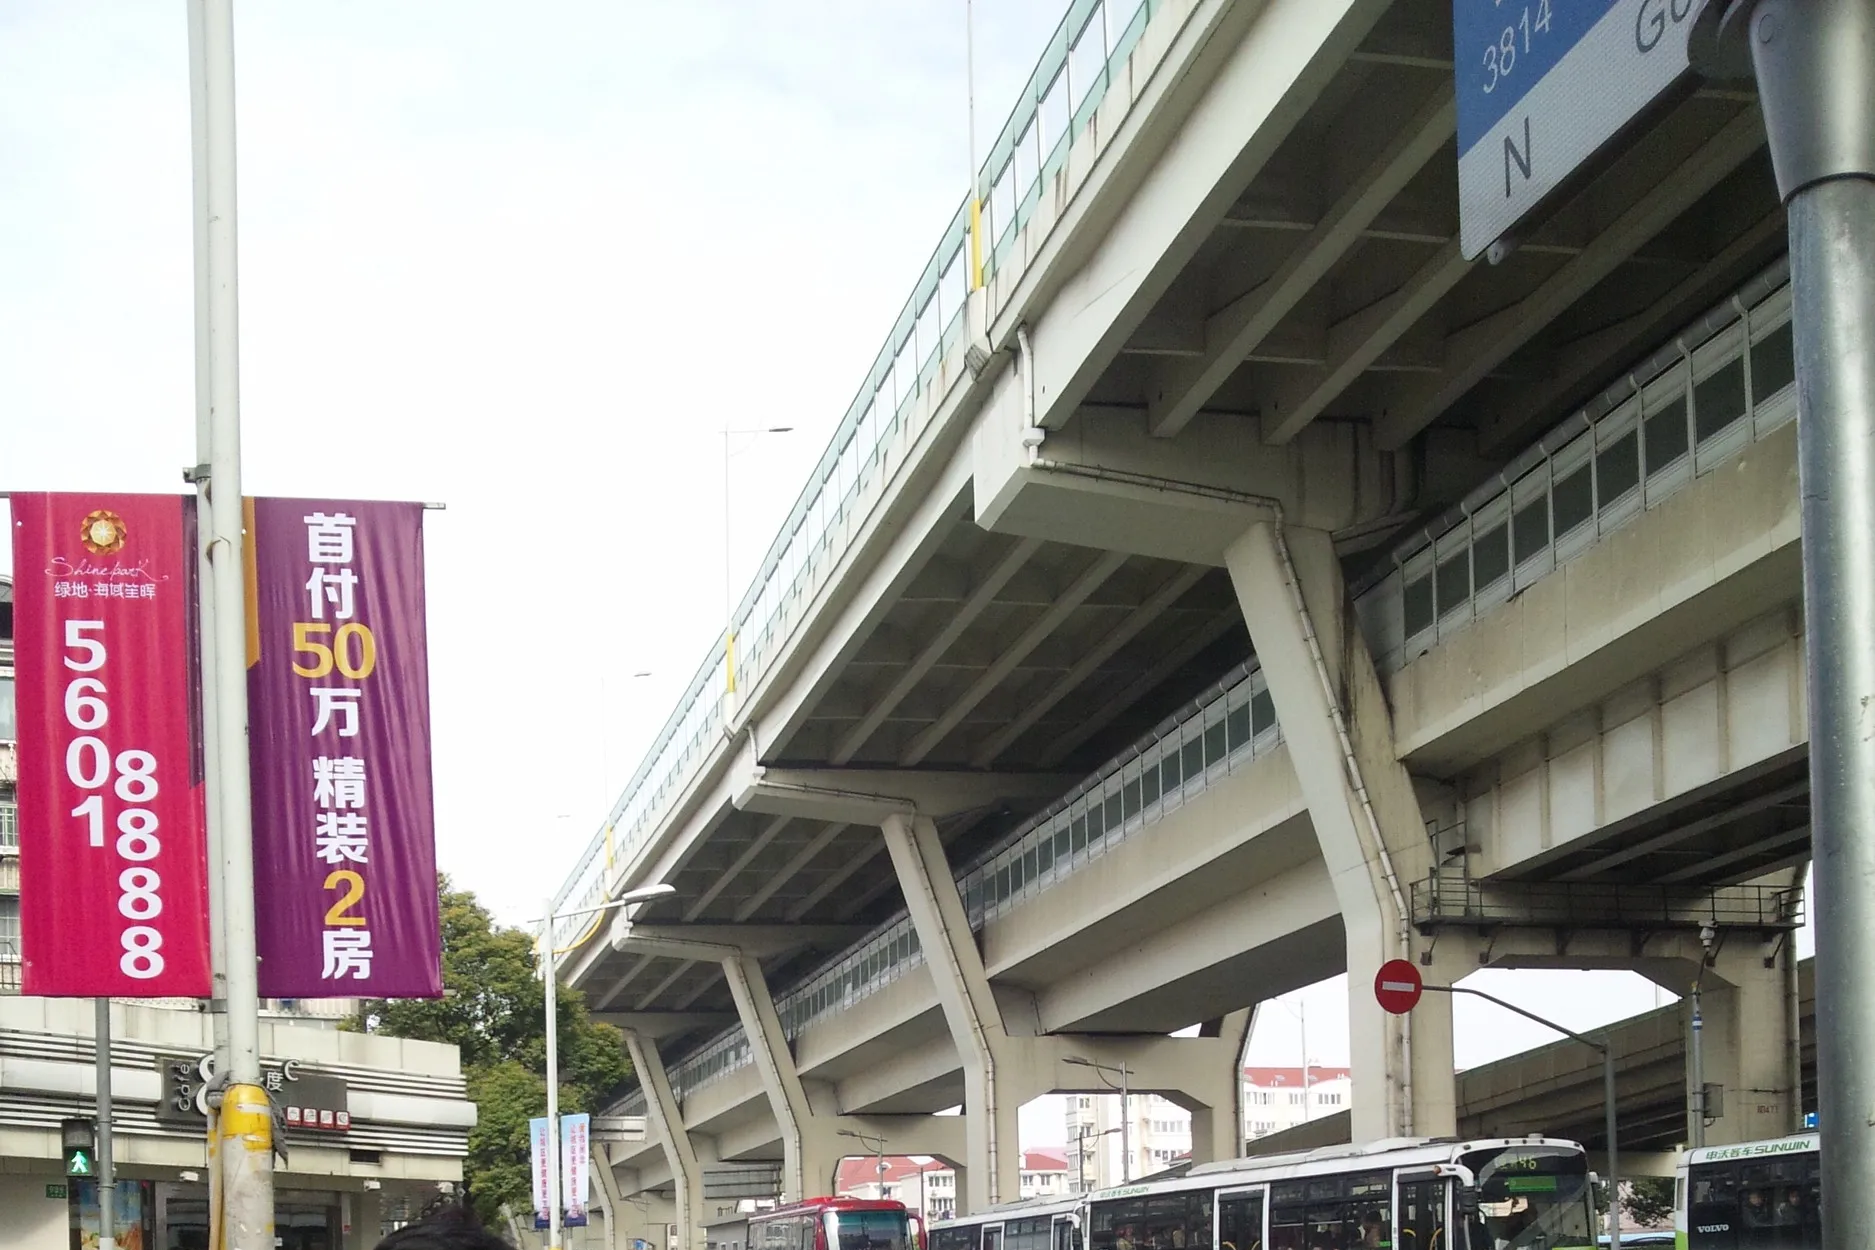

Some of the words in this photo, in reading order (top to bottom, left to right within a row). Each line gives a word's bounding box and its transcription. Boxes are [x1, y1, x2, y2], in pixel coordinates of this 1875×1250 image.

[1482, 0, 1553, 94] 3814
[1503, 116, 1532, 199] N
[63, 619, 111, 848] 5601
[114, 749, 165, 980] 8888
[312, 755, 374, 981] 精装2房
[1754, 1140, 1811, 1154] SUNWIN
[1697, 1224, 1729, 1233] VOLVO
